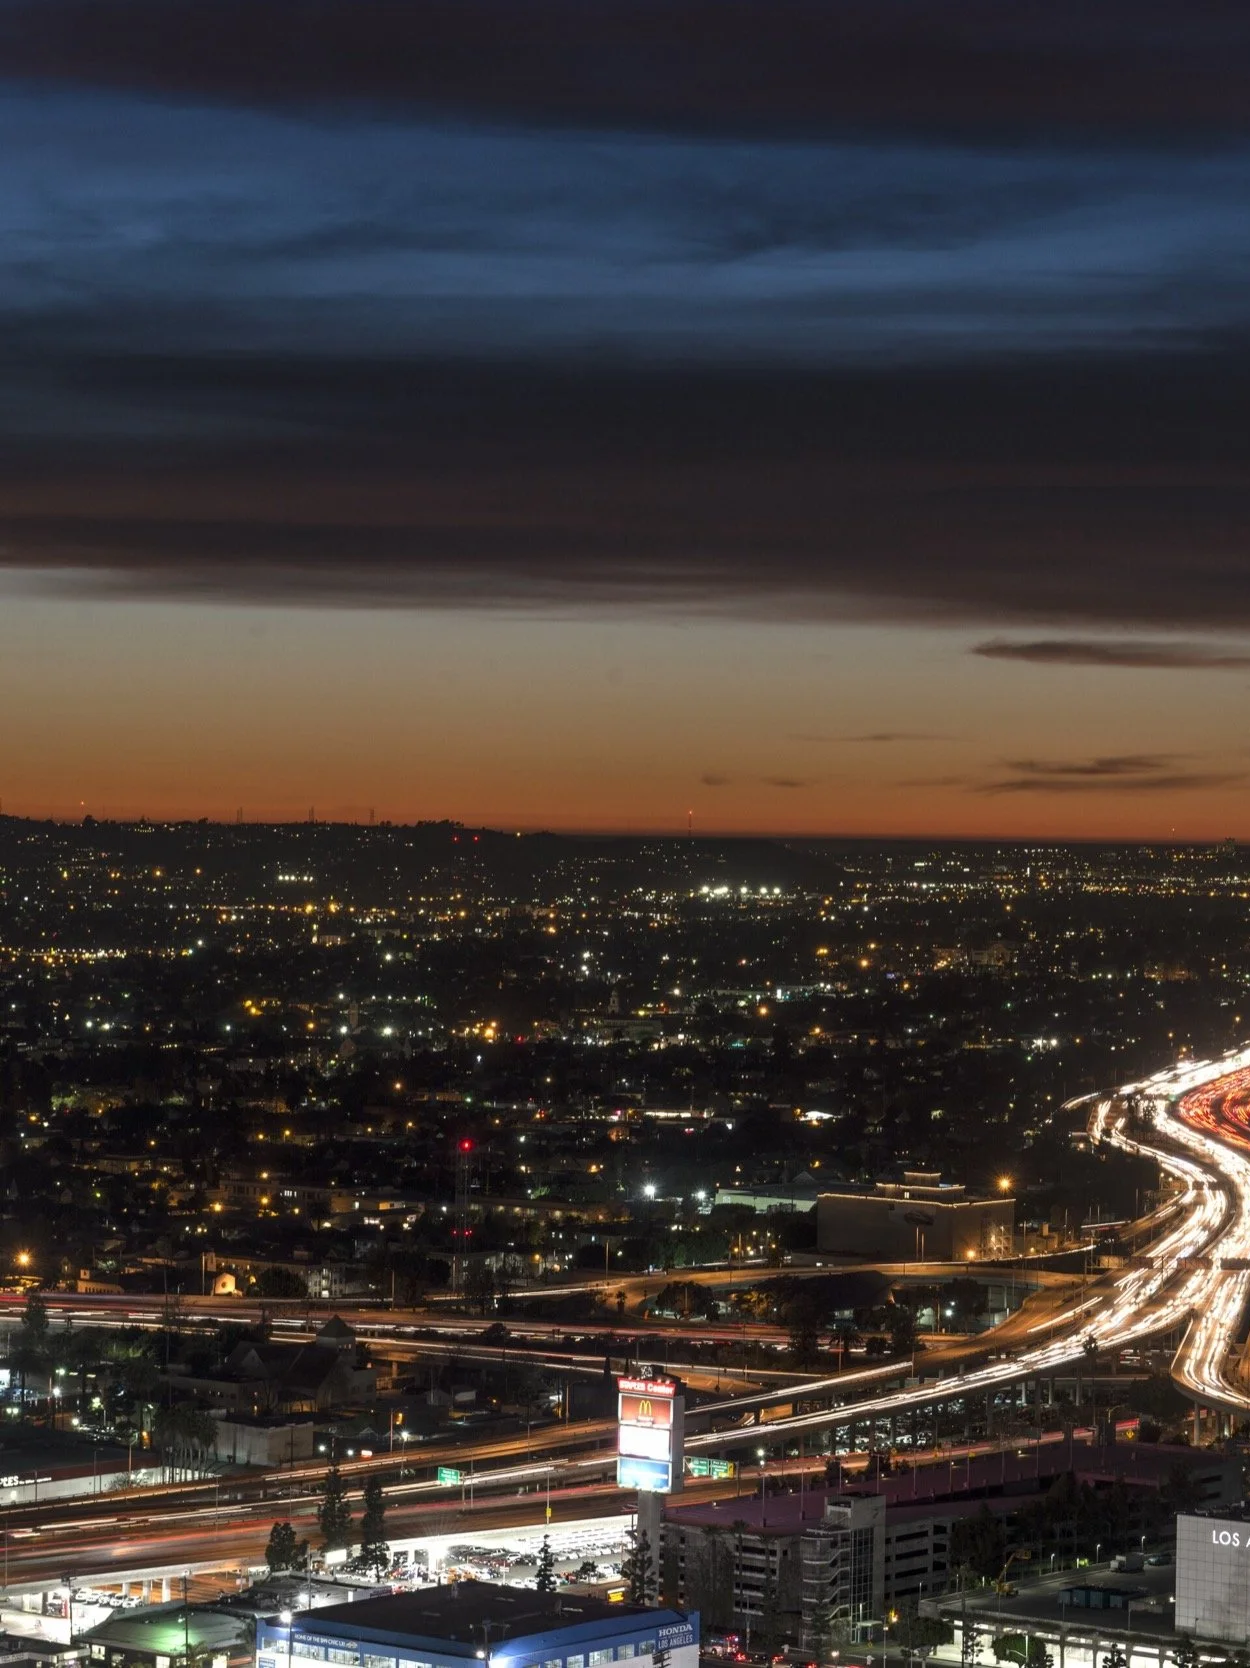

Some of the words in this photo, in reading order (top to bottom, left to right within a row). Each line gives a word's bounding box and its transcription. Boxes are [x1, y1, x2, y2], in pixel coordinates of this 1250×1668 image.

[1212, 1530, 1240, 1547] LOS
[658, 1624, 693, 1637] HONDA
[658, 1639, 669, 1649] LOS
[669, 1634, 693, 1647] ANGELES
